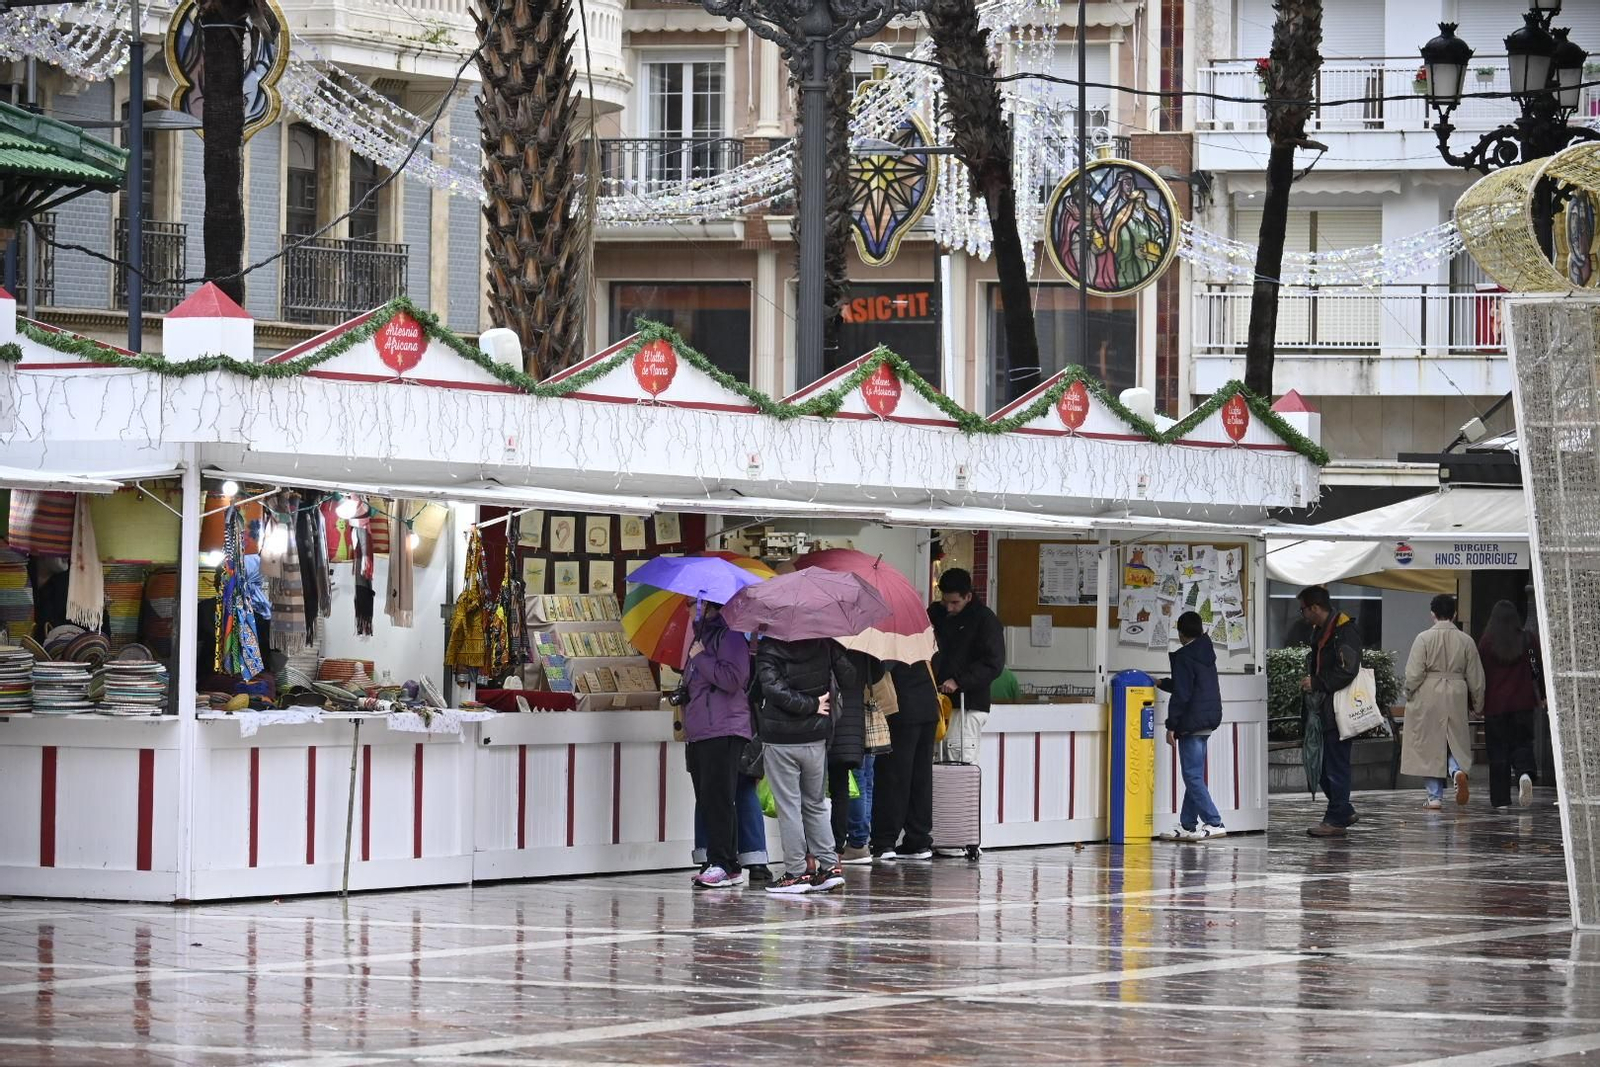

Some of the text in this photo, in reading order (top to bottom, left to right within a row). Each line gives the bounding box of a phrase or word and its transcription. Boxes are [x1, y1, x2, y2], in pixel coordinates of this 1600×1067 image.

[840, 292, 929, 323] ASIC-FIT
[384, 336, 419, 355] Africana
[641, 364, 649, 376] de
[1454, 544, 1499, 552] BURGUER
[1435, 552, 1518, 565] HNOS. RODRIGUEZ
